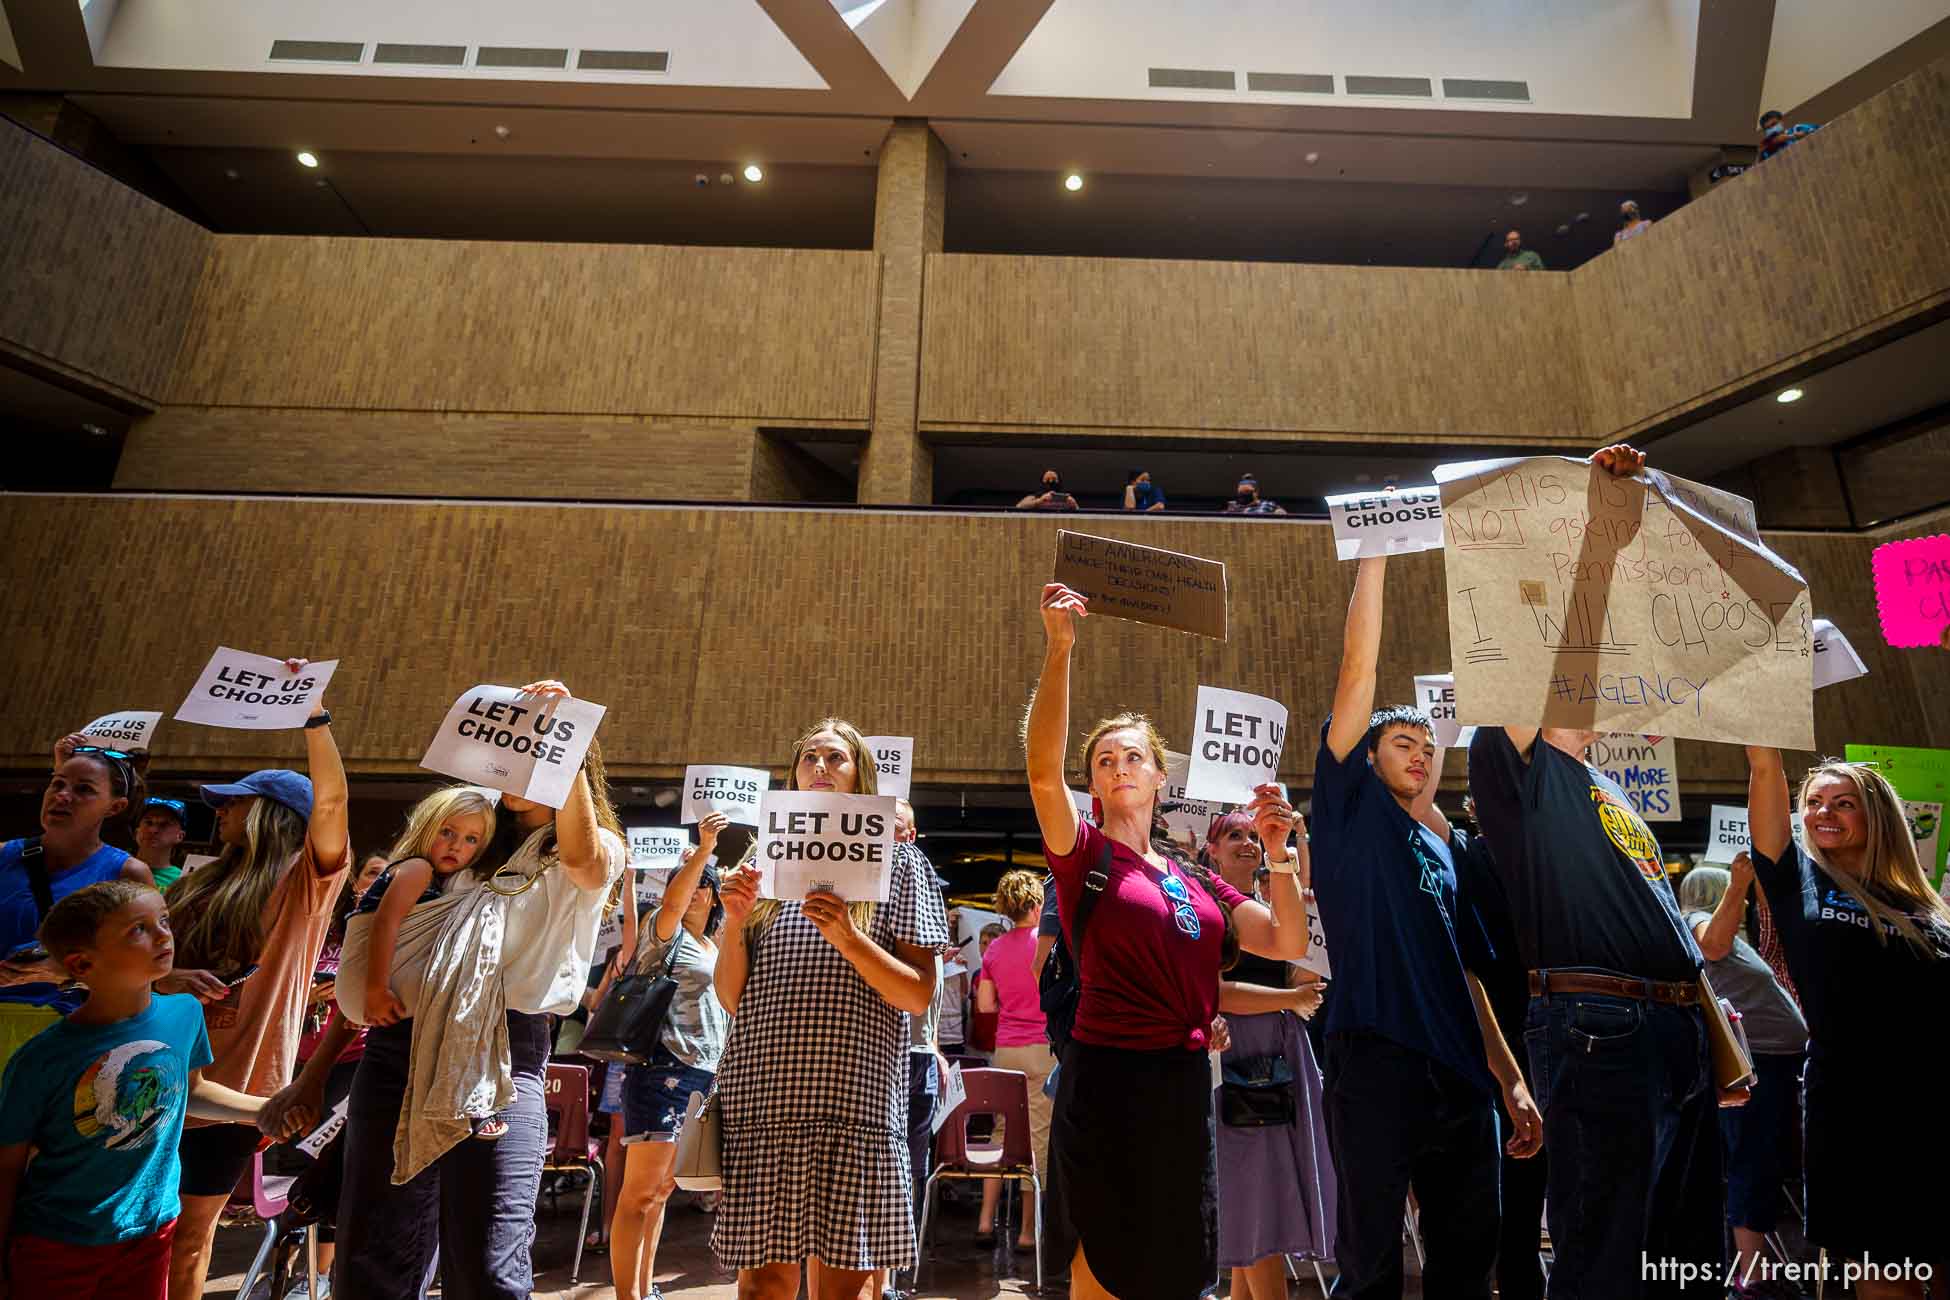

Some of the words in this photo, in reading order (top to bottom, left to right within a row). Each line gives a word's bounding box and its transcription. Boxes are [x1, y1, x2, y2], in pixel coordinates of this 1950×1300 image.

[1344, 496, 1391, 512] LET
[1401, 494, 1438, 506] US
[1346, 506, 1442, 528] CHOOSE
[1449, 505, 1528, 545] NOT
[1457, 587, 1493, 645] I
[1523, 587, 1639, 648] WILL
[217, 666, 275, 690] LET
[281, 677, 315, 692] US
[208, 684, 308, 706] CHOOSE
[1428, 688, 1455, 703] LE
[1550, 672, 1709, 717] #AGENCY
[92, 719, 121, 729] LET
[124, 719, 147, 731] US
[468, 697, 528, 726] LET
[533, 713, 575, 741] US
[1205, 709, 1262, 739] LET
[1269, 720, 1284, 749] US
[84, 727, 142, 742] CHOOSE
[458, 719, 565, 765] CHOOSE
[877, 749, 901, 762] US
[1202, 741, 1279, 770] CHOOS
[1596, 741, 1657, 767] Dunn
[694, 777, 728, 789] LET
[734, 780, 758, 792] US
[1624, 764, 1671, 789] MORE
[692, 790, 758, 804] CHOOSE
[1169, 785, 1186, 799] LE
[1627, 788, 1670, 814] SKS
[1174, 801, 1207, 817] HOOSE
[768, 811, 829, 835] LET
[840, 813, 885, 837] US
[1719, 819, 1747, 833] LET
[633, 847, 681, 855] CHOOSE
[634, 837, 659, 846] LET
[663, 837, 681, 846] US
[766, 841, 883, 863] CHOOSE
[1821, 907, 1869, 928] Bold
